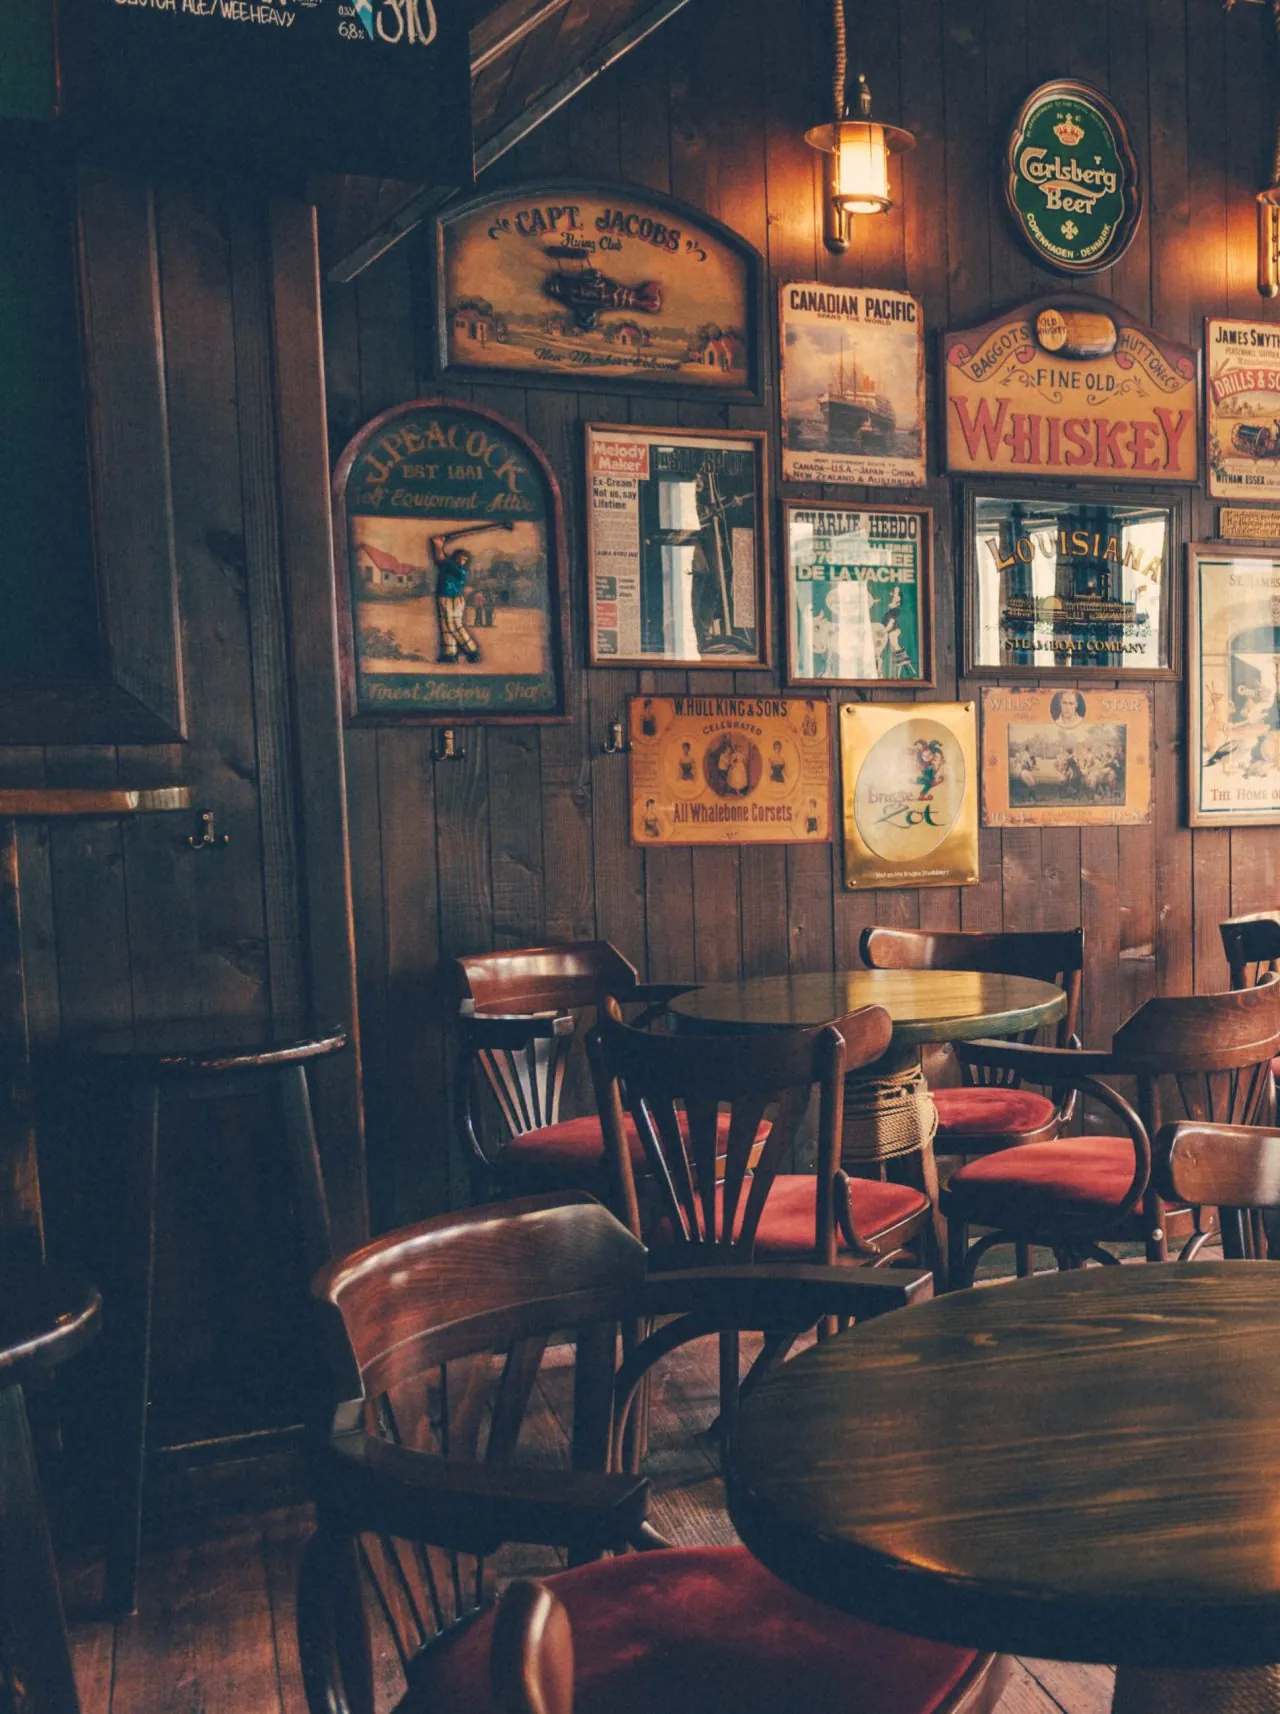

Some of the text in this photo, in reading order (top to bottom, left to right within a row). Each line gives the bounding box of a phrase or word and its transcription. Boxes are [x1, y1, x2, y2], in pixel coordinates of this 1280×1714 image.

[1019, 147, 1117, 194] Carlsberg
[1045, 188, 1097, 215] Beer
[595, 208, 682, 251] JACOBS
[1026, 213, 1112, 259] COPENHAGEN DENMARK
[599, 235, 623, 252] Club
[790, 290, 916, 323] CANADIAN PACIFIC
[864, 317, 892, 326] WORLD
[1216, 327, 1248, 345] JAMES
[971, 326, 1031, 378] BAGGOTS
[1036, 369, 1115, 391] FINE OLD
[1215, 371, 1255, 397] DRILLS
[1258, 371, 1265, 389] &
[950, 396, 1193, 472] WHISKEY
[594, 443, 646, 460] Melody
[598, 456, 641, 472] Maker
[593, 477, 636, 487] Ex-Cream?
[593, 490, 608, 499] Not
[623, 492, 637, 500] say
[594, 501, 627, 511] Lifetime
[868, 516, 917, 539] HEBDO
[985, 530, 1163, 583] LOUISIANA
[799, 566, 915, 583] DE LA VACHE
[1086, 640, 1147, 654] COMPANY
[756, 701, 788, 717] SONS
[703, 721, 762, 736] CELEBRATED
[1211, 788, 1232, 802] THE
[1237, 788, 1267, 801] HOME
[673, 802, 792, 823] All Whalebone Corsets
